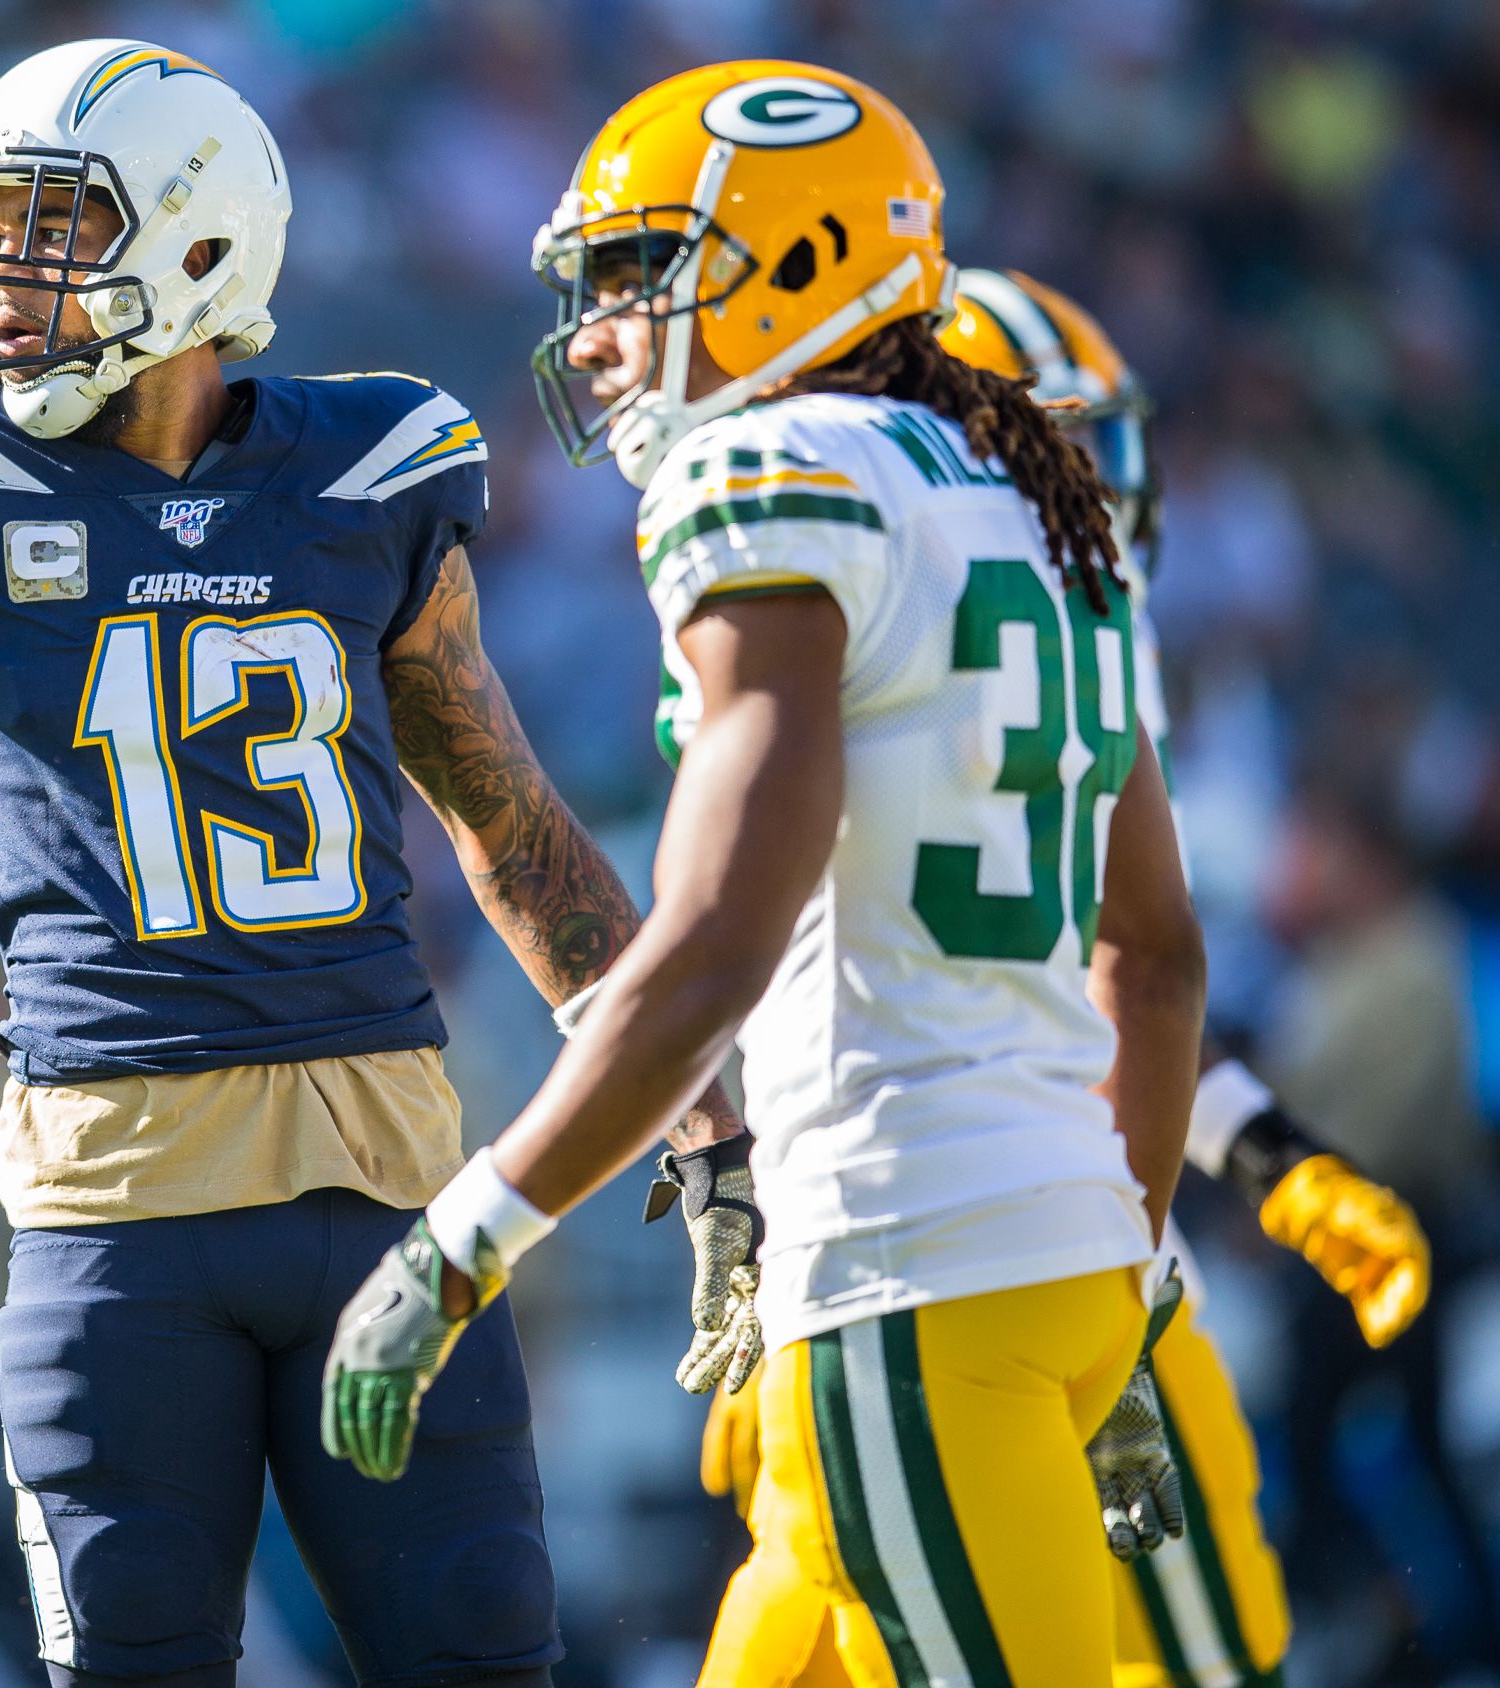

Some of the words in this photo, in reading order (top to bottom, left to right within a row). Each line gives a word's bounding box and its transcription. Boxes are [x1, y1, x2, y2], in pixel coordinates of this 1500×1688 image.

[701, 76, 861, 148] G
[188, 157, 203, 173] 13
[11, 527, 80, 580] C
[182, 530, 200, 541] NFL
[127, 572, 273, 605] CHARGERS
[73, 610, 367, 941] 13
[912, 560, 1137, 967] 38
